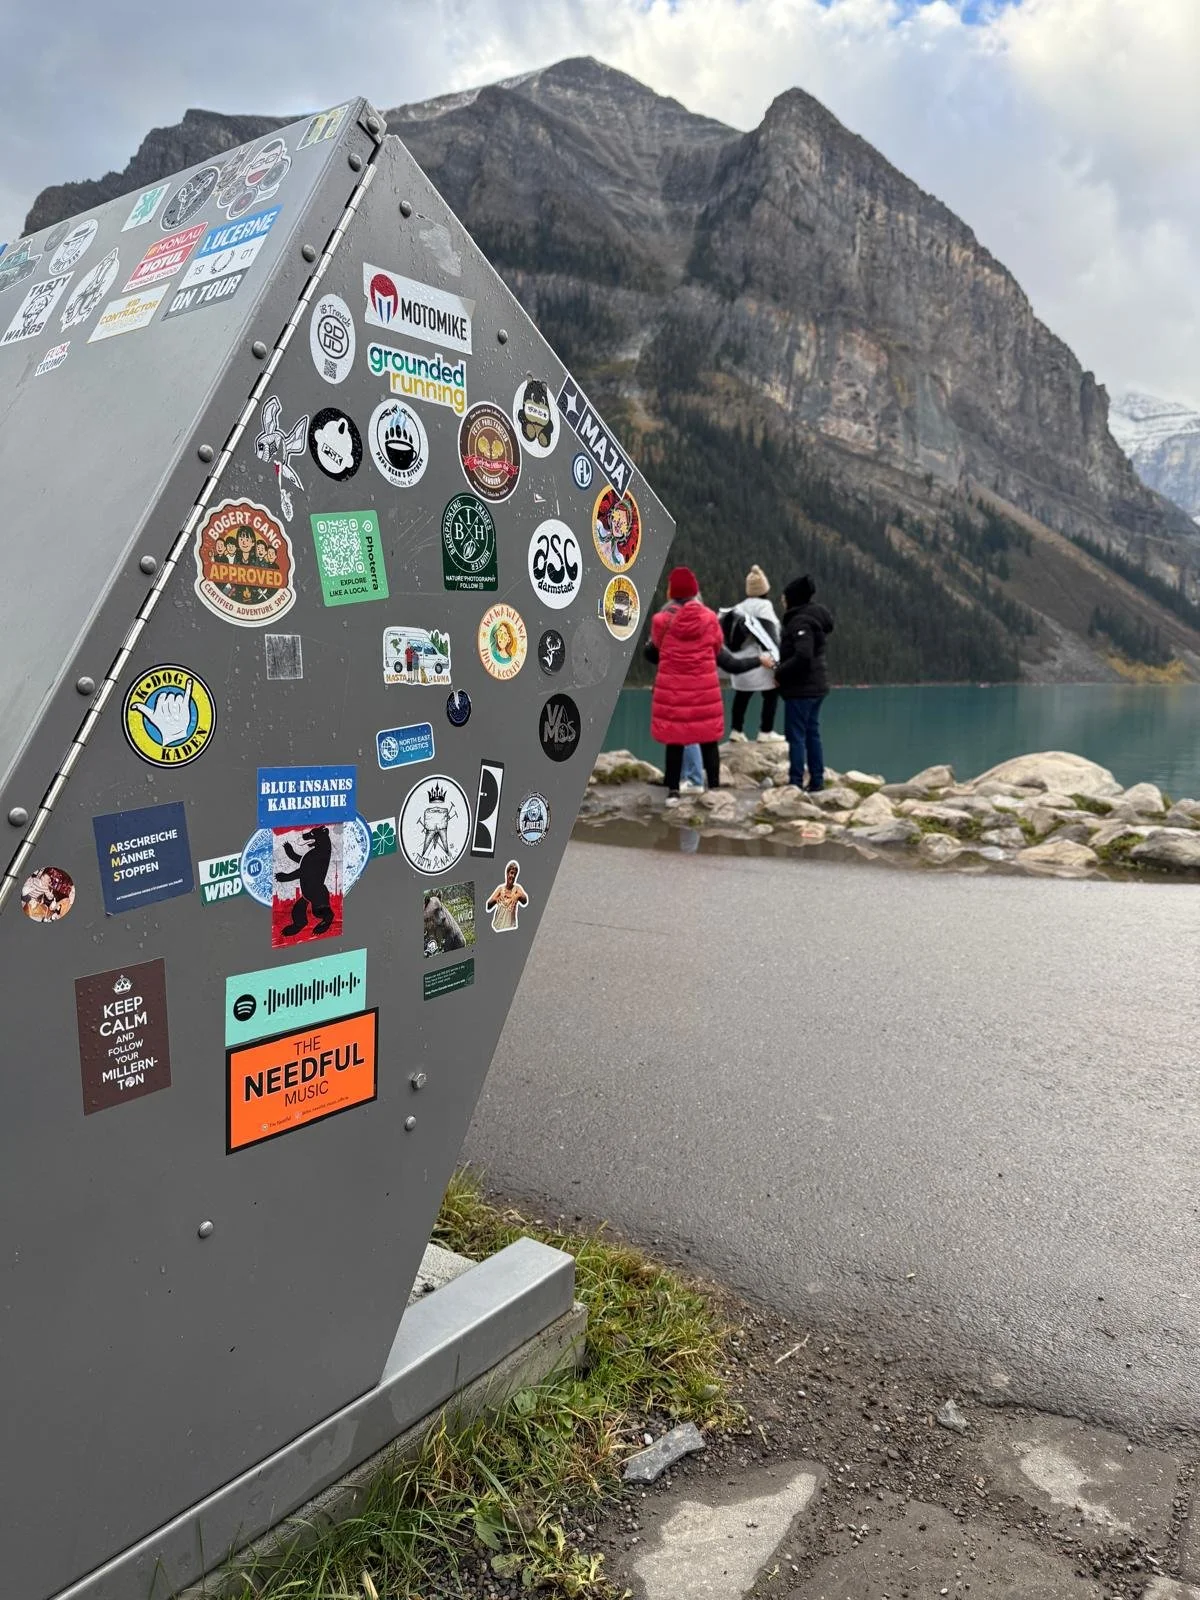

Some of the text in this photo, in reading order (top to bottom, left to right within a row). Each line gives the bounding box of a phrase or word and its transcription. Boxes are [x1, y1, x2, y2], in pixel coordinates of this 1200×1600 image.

[201, 211, 278, 252] LUCERNE
[138, 250, 184, 280] MOTUL
[30, 275, 70, 298] TASTY
[169, 288, 198, 313] ON
[196, 273, 243, 305] TOUR
[400, 297, 468, 341] MOTOMIKE
[4, 321, 45, 342] WANGS
[370, 346, 464, 388] grounded
[391, 371, 466, 414] running
[580, 413, 625, 491] MAJA
[207, 511, 282, 549] BOGERT GANG
[444, 499, 462, 556] BACKPACKING
[209, 566, 284, 586] APPROVED
[340, 576, 368, 586] EXPLORE
[537, 579, 575, 594] darmstadt
[203, 582, 288, 616] CERTIFIED ADVENTURE SPOT
[329, 585, 369, 597] LIKE A LOCAL
[160, 726, 208, 761] KADEN
[399, 734, 431, 747] NORTH EAST
[402, 741, 429, 753] LOGISTICS
[261, 778, 353, 795] BLUE INSANES
[267, 794, 347, 812] KARLSRUHE
[109, 829, 178, 854] ARSCHREICHE
[111, 848, 155, 868] MÄNNER
[113, 861, 160, 882] STOPPEN
[204, 875, 242, 902] WIRD
[103, 996, 143, 1019] KEEP
[99, 1011, 148, 1037] CALM
[108, 1038, 144, 1057] FOLLOW
[115, 1031, 135, 1045] AND
[293, 1035, 321, 1056] THE
[102, 1056, 159, 1084] MILLERN-
[115, 1051, 139, 1066] YOUR
[243, 1042, 366, 1103] NEEDFUL
[284, 1080, 330, 1107] MUSIC
